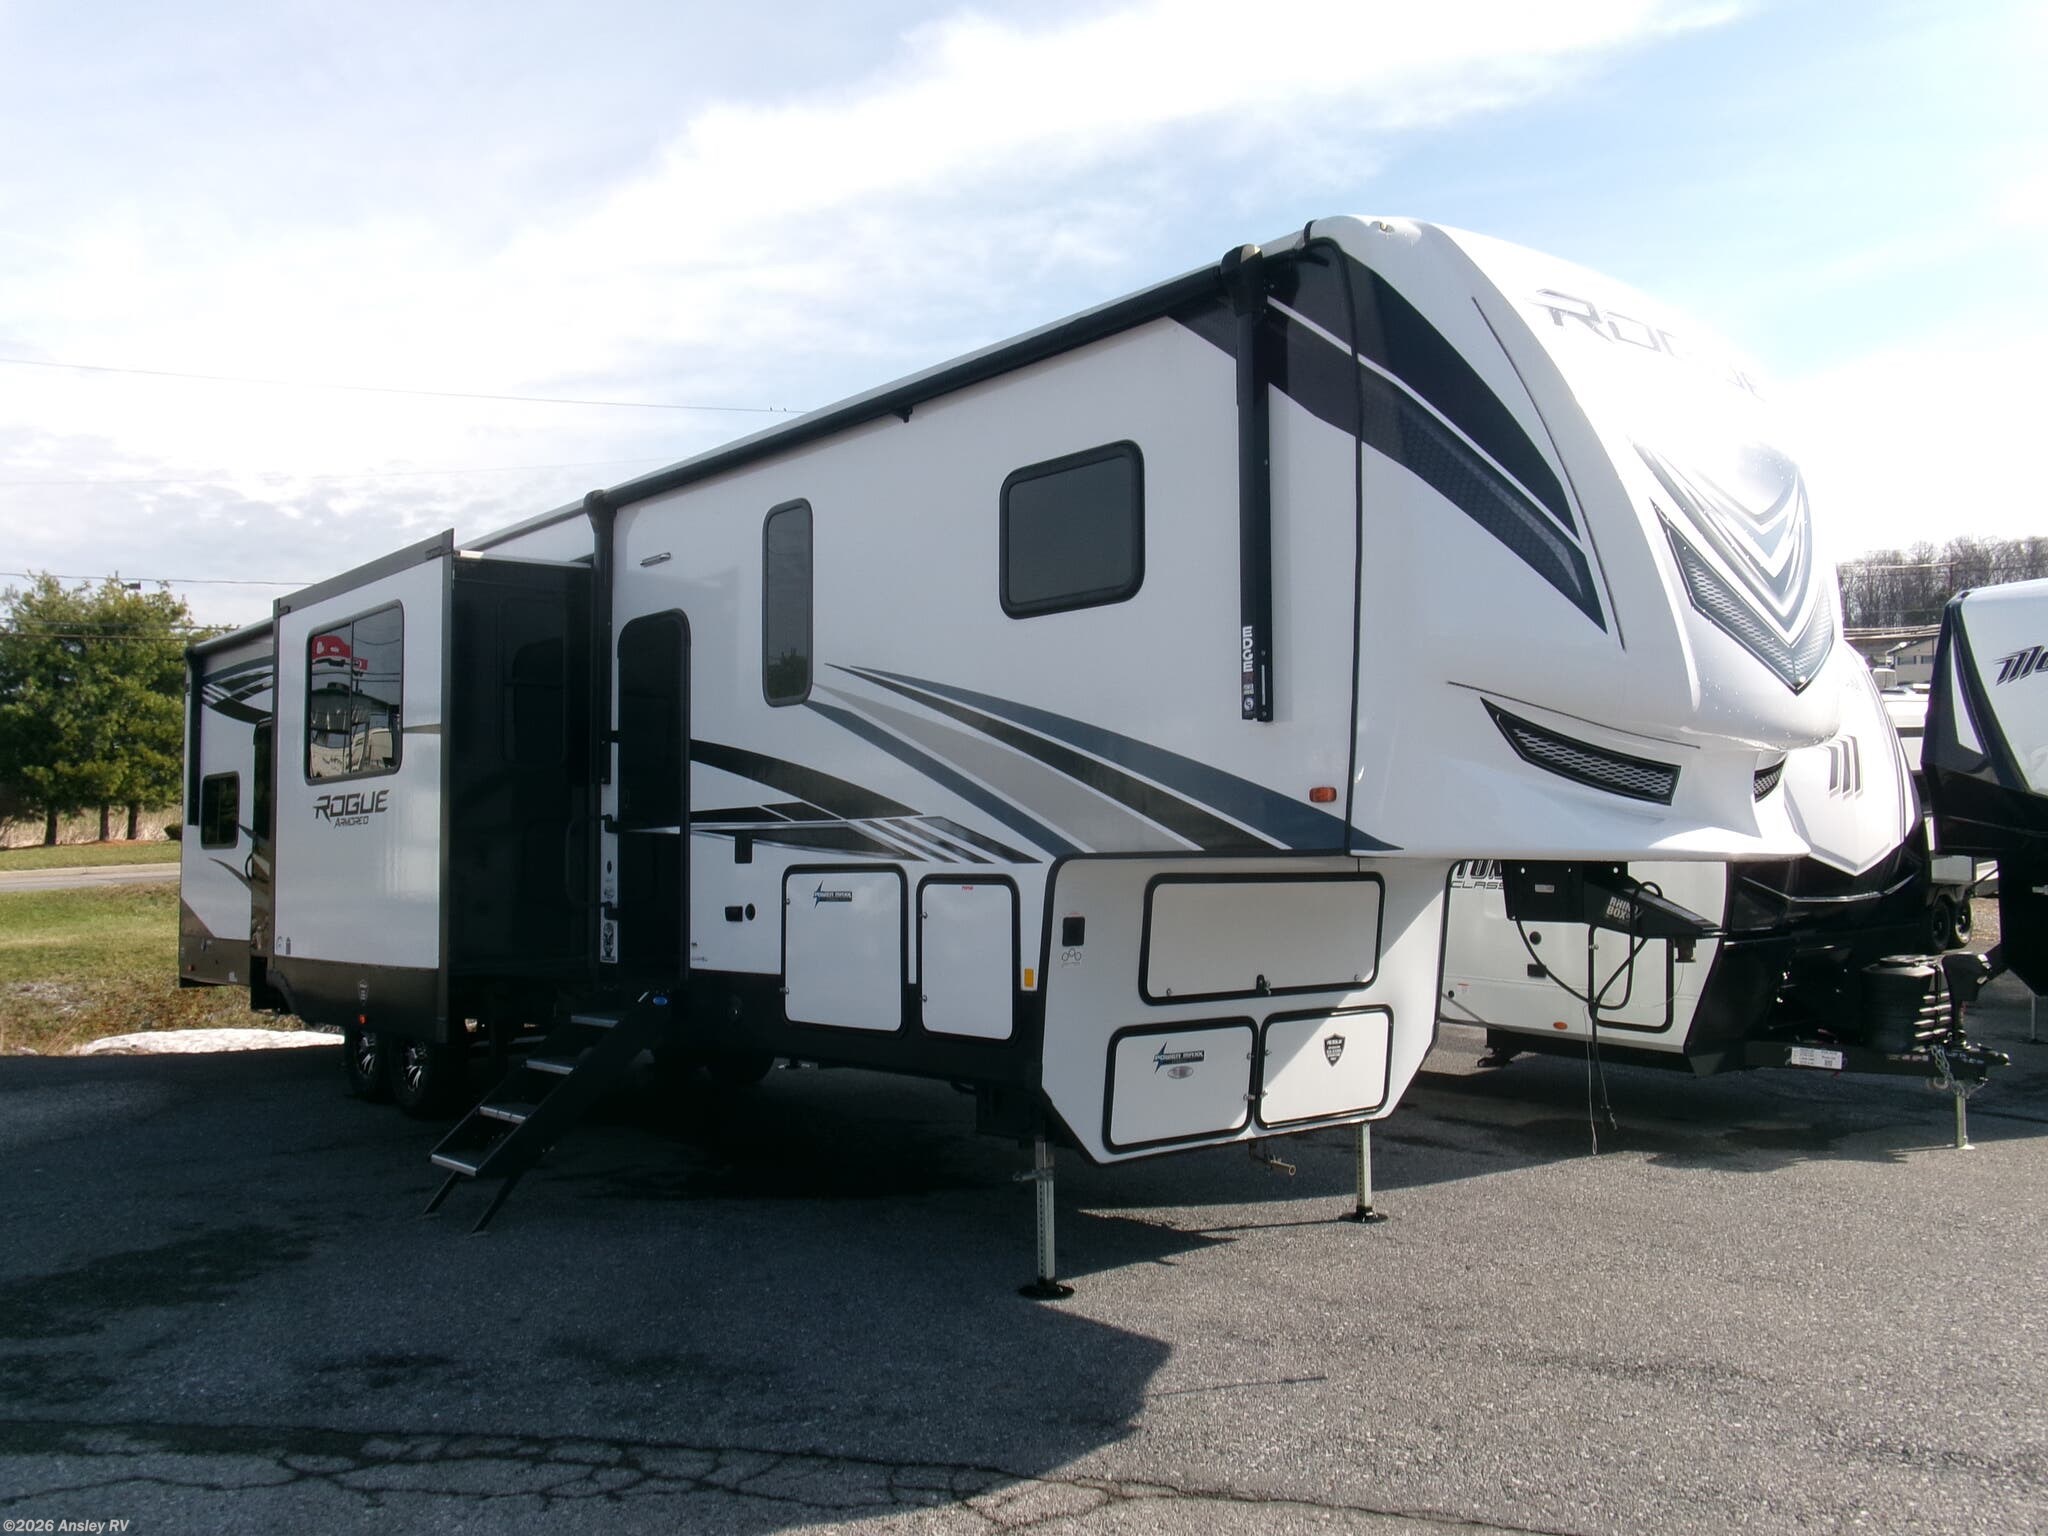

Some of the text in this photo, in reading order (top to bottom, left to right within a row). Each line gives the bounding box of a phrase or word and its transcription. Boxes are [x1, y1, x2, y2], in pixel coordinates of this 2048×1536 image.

[1242, 625, 1253, 672] EDGE
[313, 789, 390, 823] ROGUE
[334, 815, 369, 829] ARMORED
[1606, 904, 1627, 920] BOX
[1154, 1053, 1181, 1061] POWER
